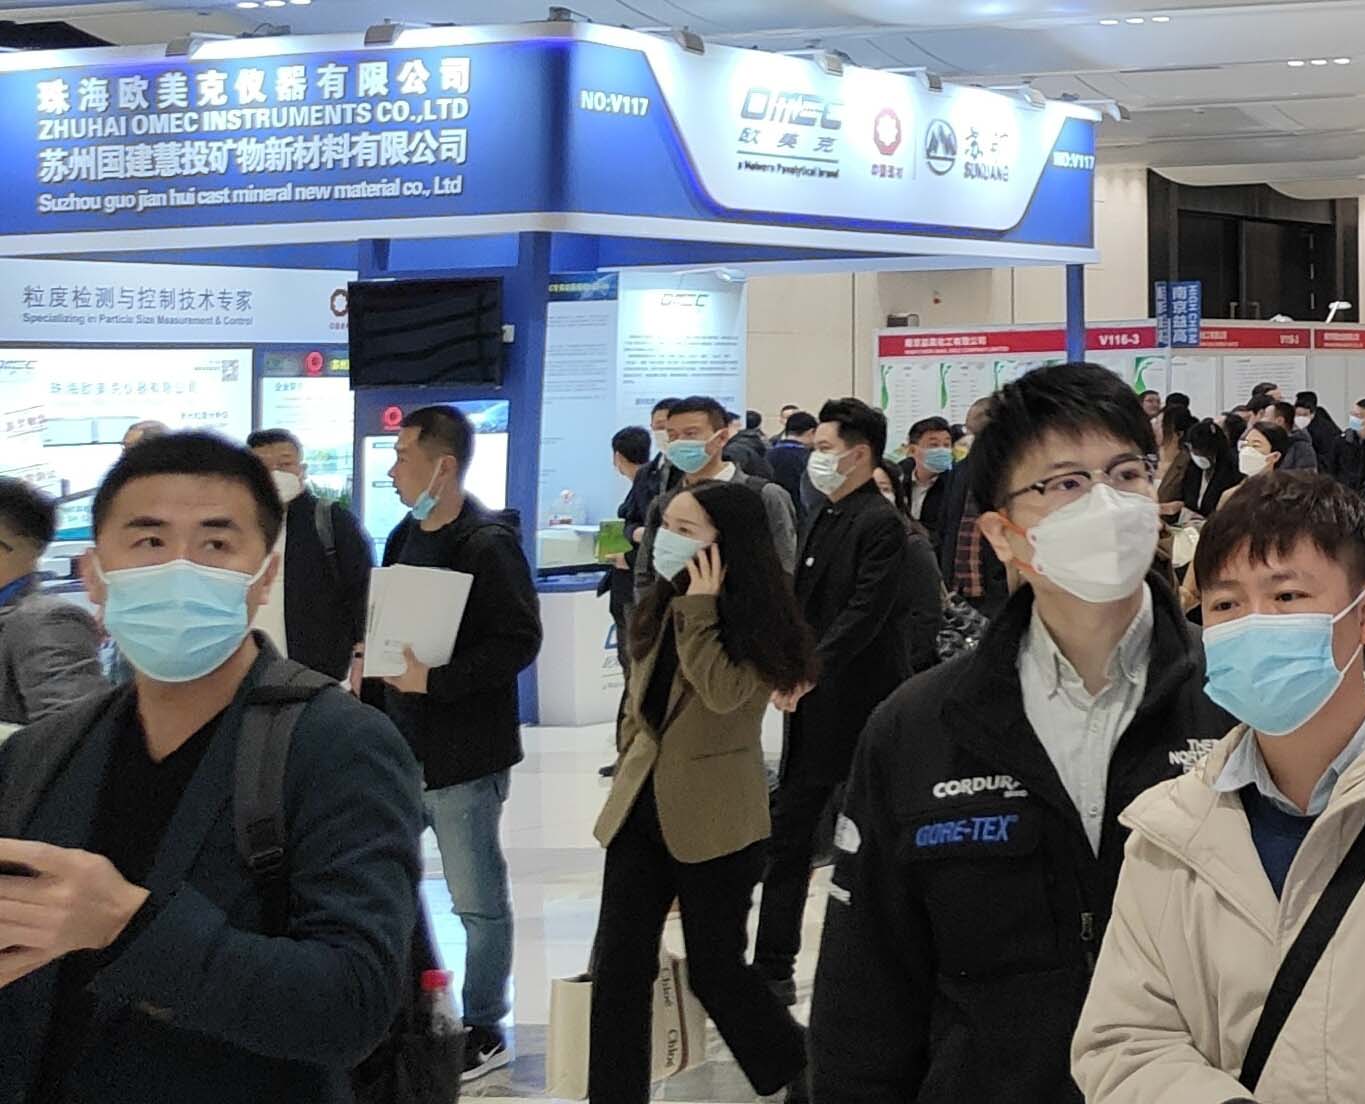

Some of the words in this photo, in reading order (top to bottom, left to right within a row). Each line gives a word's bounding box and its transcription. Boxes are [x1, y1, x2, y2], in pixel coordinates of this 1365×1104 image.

[36, 57, 471, 115] 珠海欧美克仪器有限公司
[579, 89, 649, 117] NO:V117
[38, 116, 127, 140] ZHUHAI
[131, 112, 199, 135] OMEC
[202, 102, 372, 132] INSTRUMENTS
[376, 97, 470, 123] CO.,LTD
[38, 128, 468, 183] 苏州国建慧投矿物新材料有限公司
[39, 192, 101, 213] Suzhou
[102, 193, 136, 213] guo
[135, 188, 168, 212] jian
[169, 187, 196, 206] hui
[197, 187, 230, 205] cast
[231, 183, 292, 203] mineral
[293, 185, 331, 201] new
[333, 178, 401, 198] material
[433, 175, 463, 195] Ltd
[23, 286, 253, 312] 粒度检测与控制技术专家
[23, 312, 85, 326] Specializing
[99, 314, 133, 325] Particle
[136, 314, 154, 324] Size
[156, 315, 213, 325] Measurement
[223, 315, 254, 326] Control
